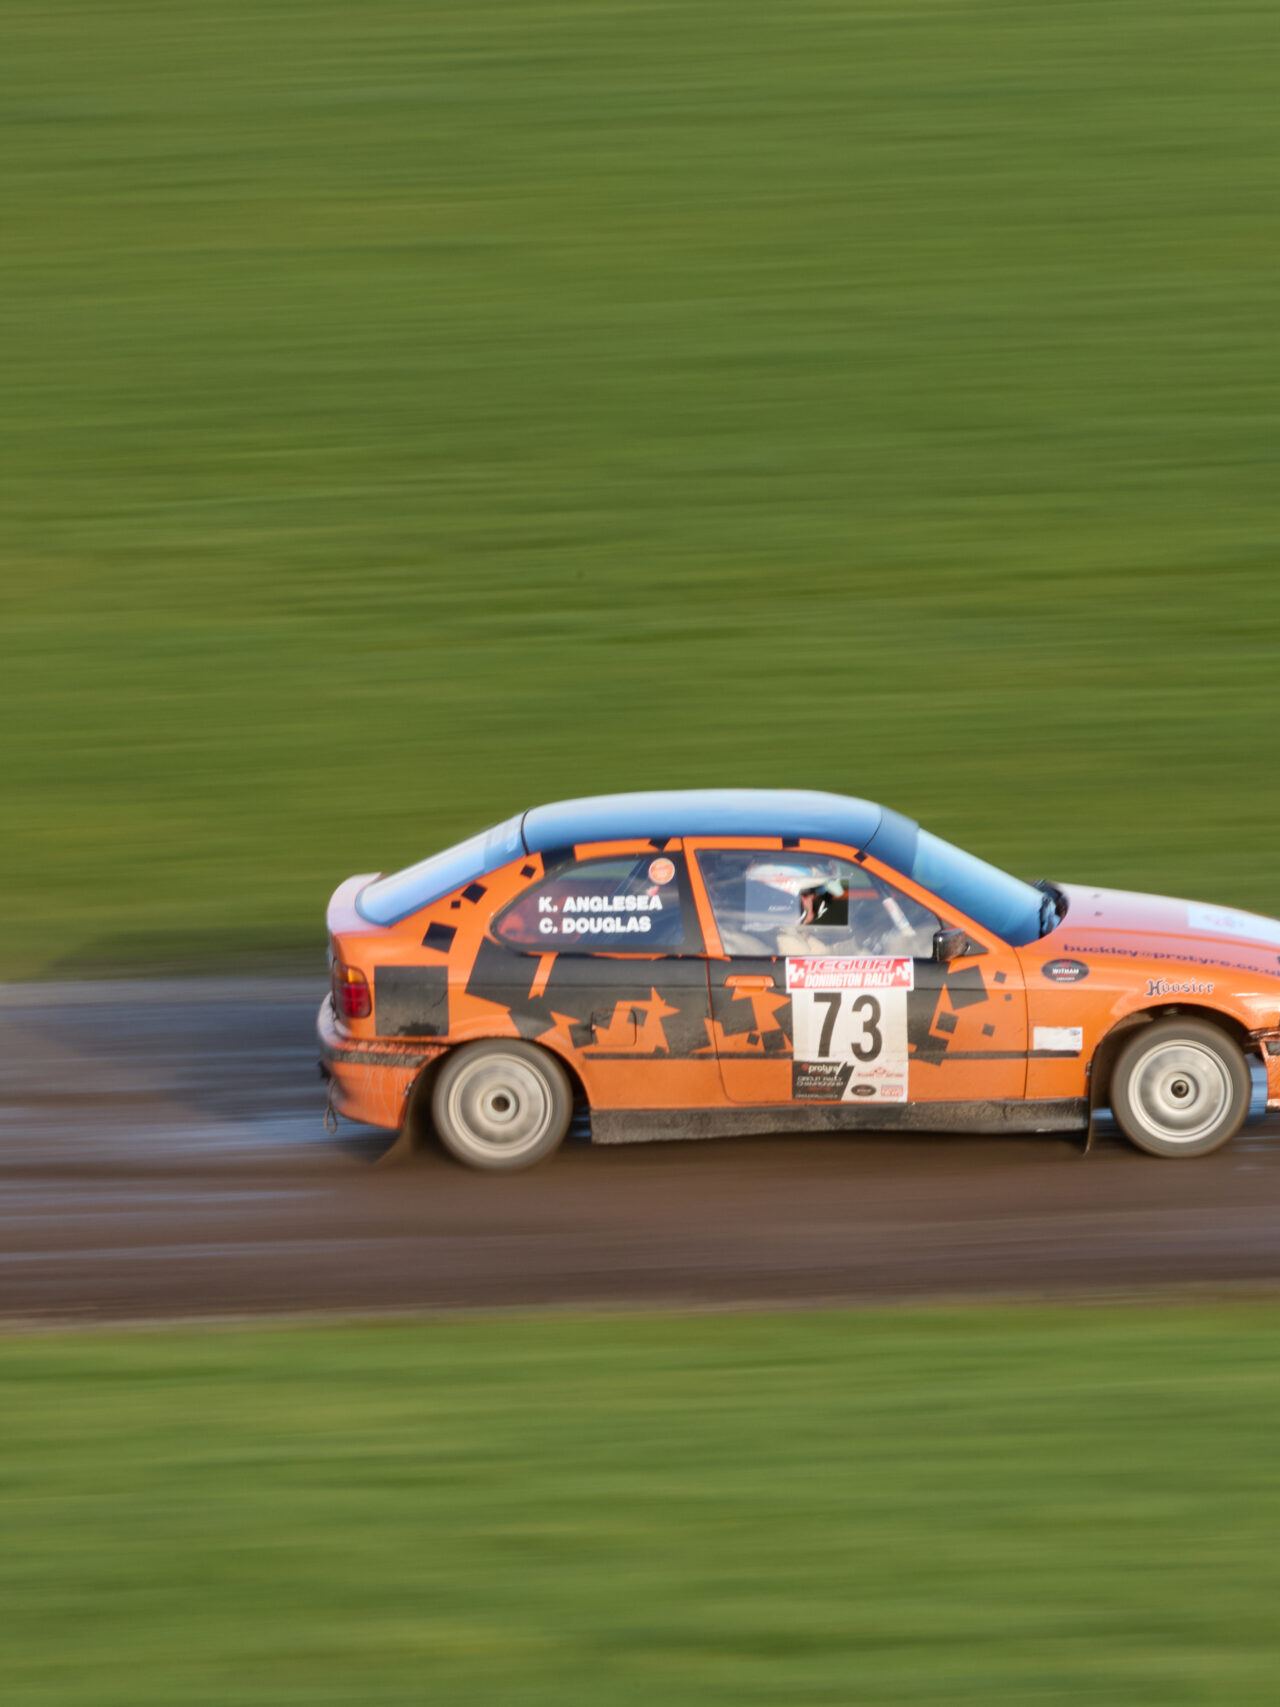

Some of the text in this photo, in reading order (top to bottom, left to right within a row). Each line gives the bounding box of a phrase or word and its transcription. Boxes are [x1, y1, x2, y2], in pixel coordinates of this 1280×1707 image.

[539, 895, 662, 913] K. ANGLESEA
[562, 916, 651, 933] DOUGLAS
[805, 972, 895, 987] DONINGTON RALLY
[1144, 978, 1213, 997] Hoosier
[814, 992, 882, 1062] 73
